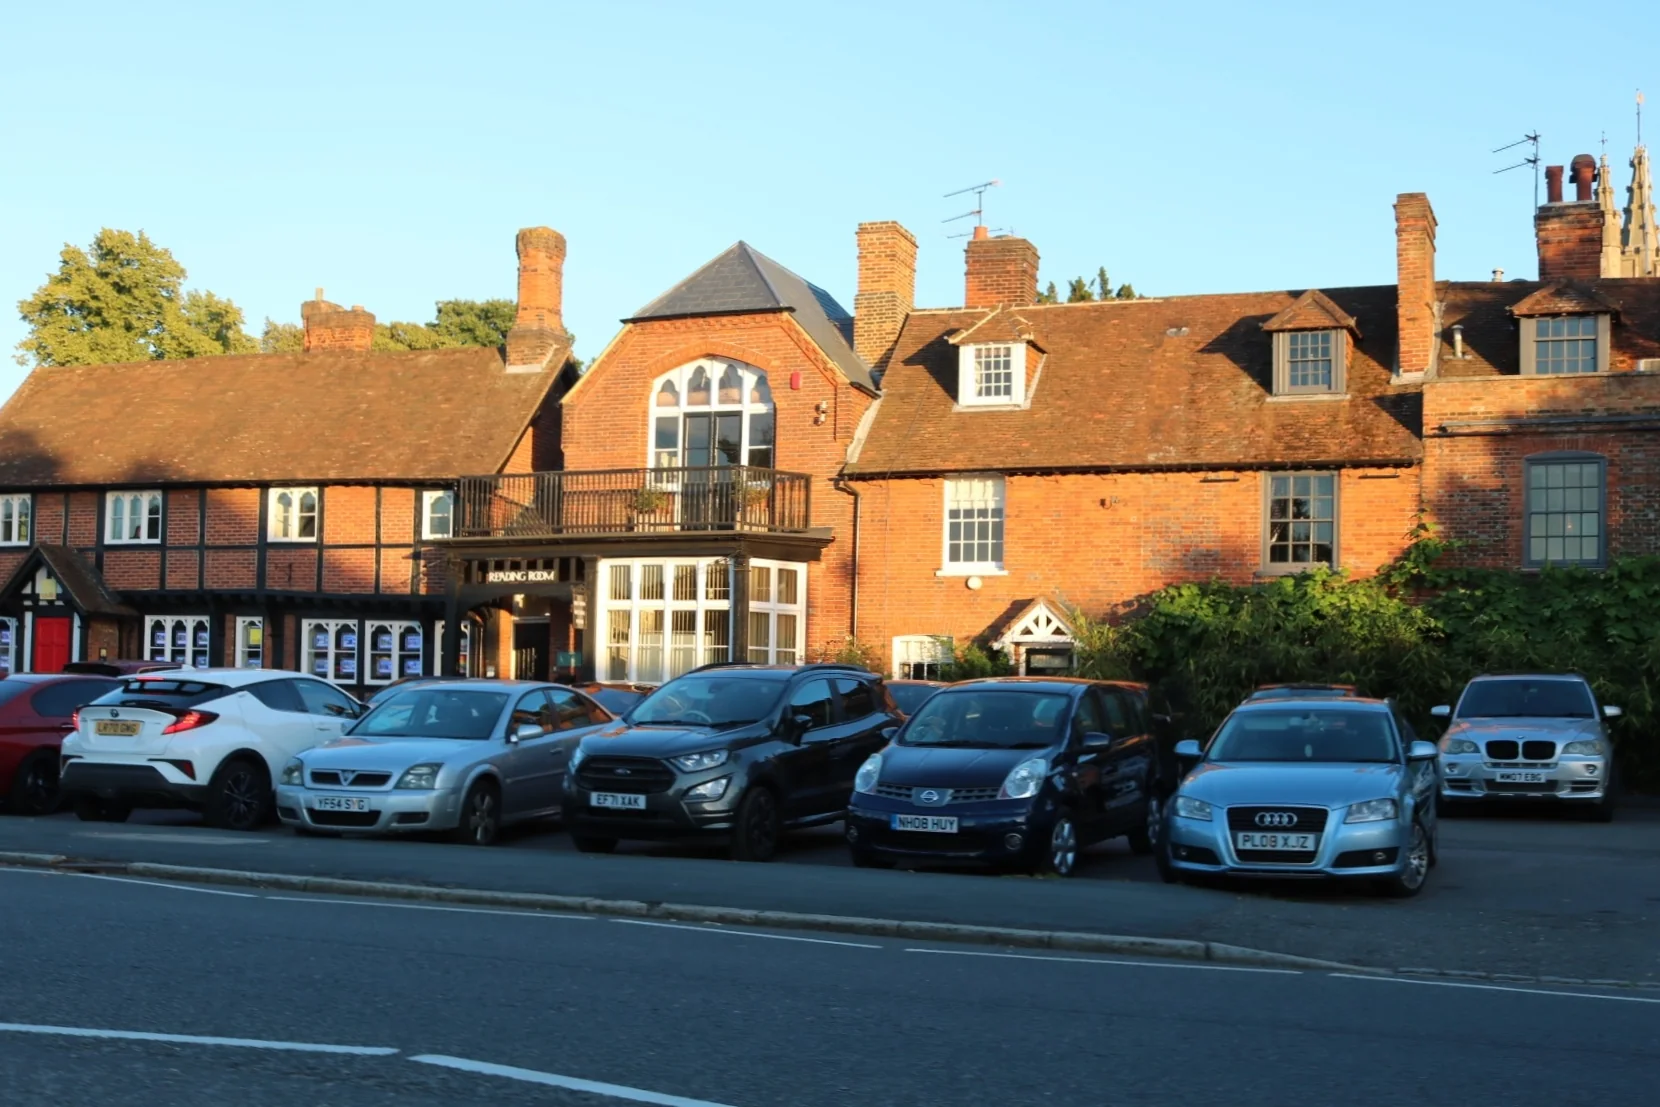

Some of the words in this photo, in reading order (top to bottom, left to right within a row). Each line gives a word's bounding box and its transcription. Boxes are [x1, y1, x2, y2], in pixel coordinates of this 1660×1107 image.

[488, 570, 526, 582] READING
[529, 570, 555, 581] ROOM
[318, 798, 341, 809] YF54
[597, 794, 618, 805] EF71
[620, 796, 640, 807] XAK
[899, 817, 928, 829] NH08
[932, 818, 955, 831] HUY
[1281, 835, 1309, 849] XJZ
